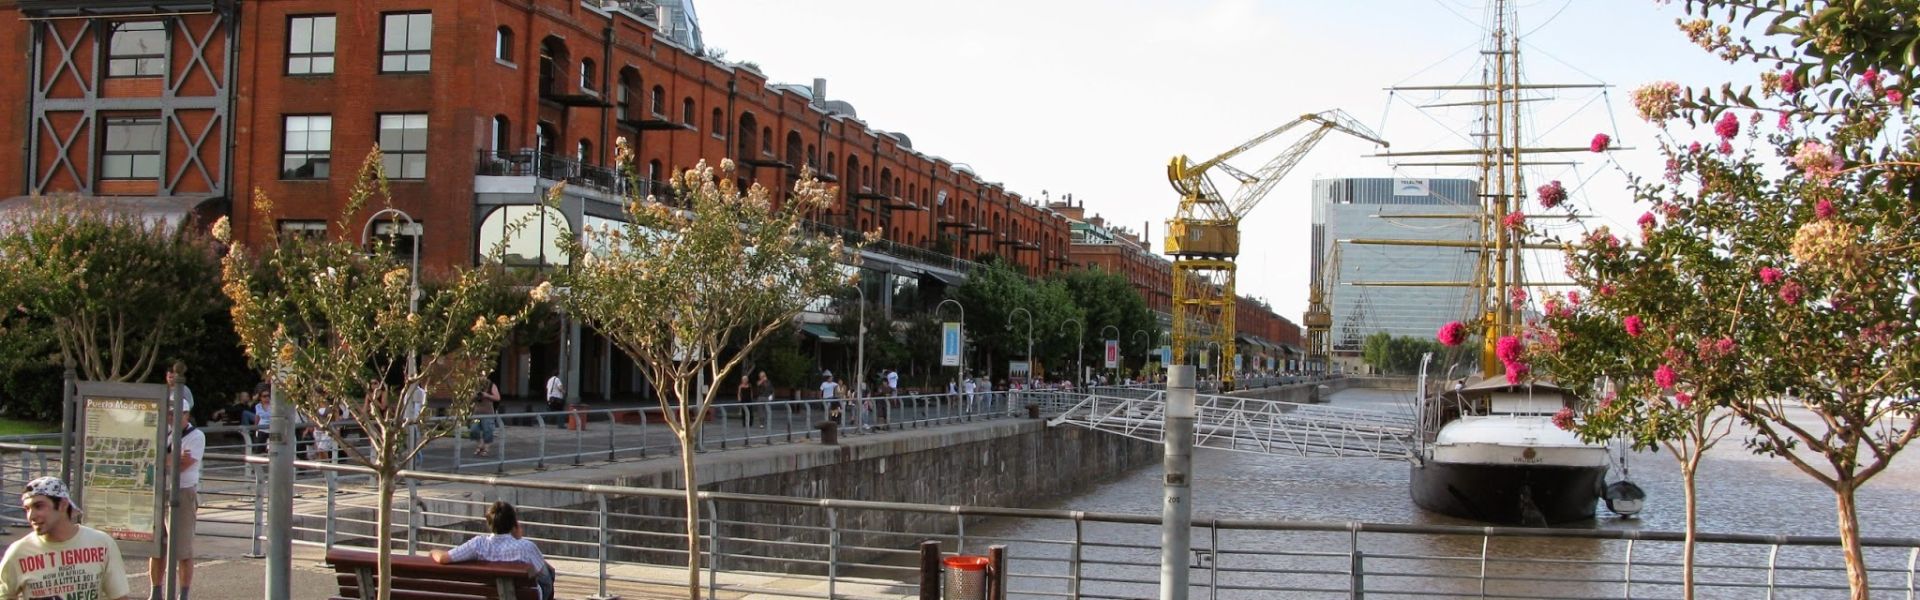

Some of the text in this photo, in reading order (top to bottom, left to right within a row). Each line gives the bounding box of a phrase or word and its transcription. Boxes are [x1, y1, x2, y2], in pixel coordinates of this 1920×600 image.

[87, 399, 147, 410] Puerto Madero
[19, 552, 56, 574] DON'T
[59, 576, 80, 585] LITTLE
[54, 585, 75, 594] EATEN
[66, 589, 98, 600] NEVE
